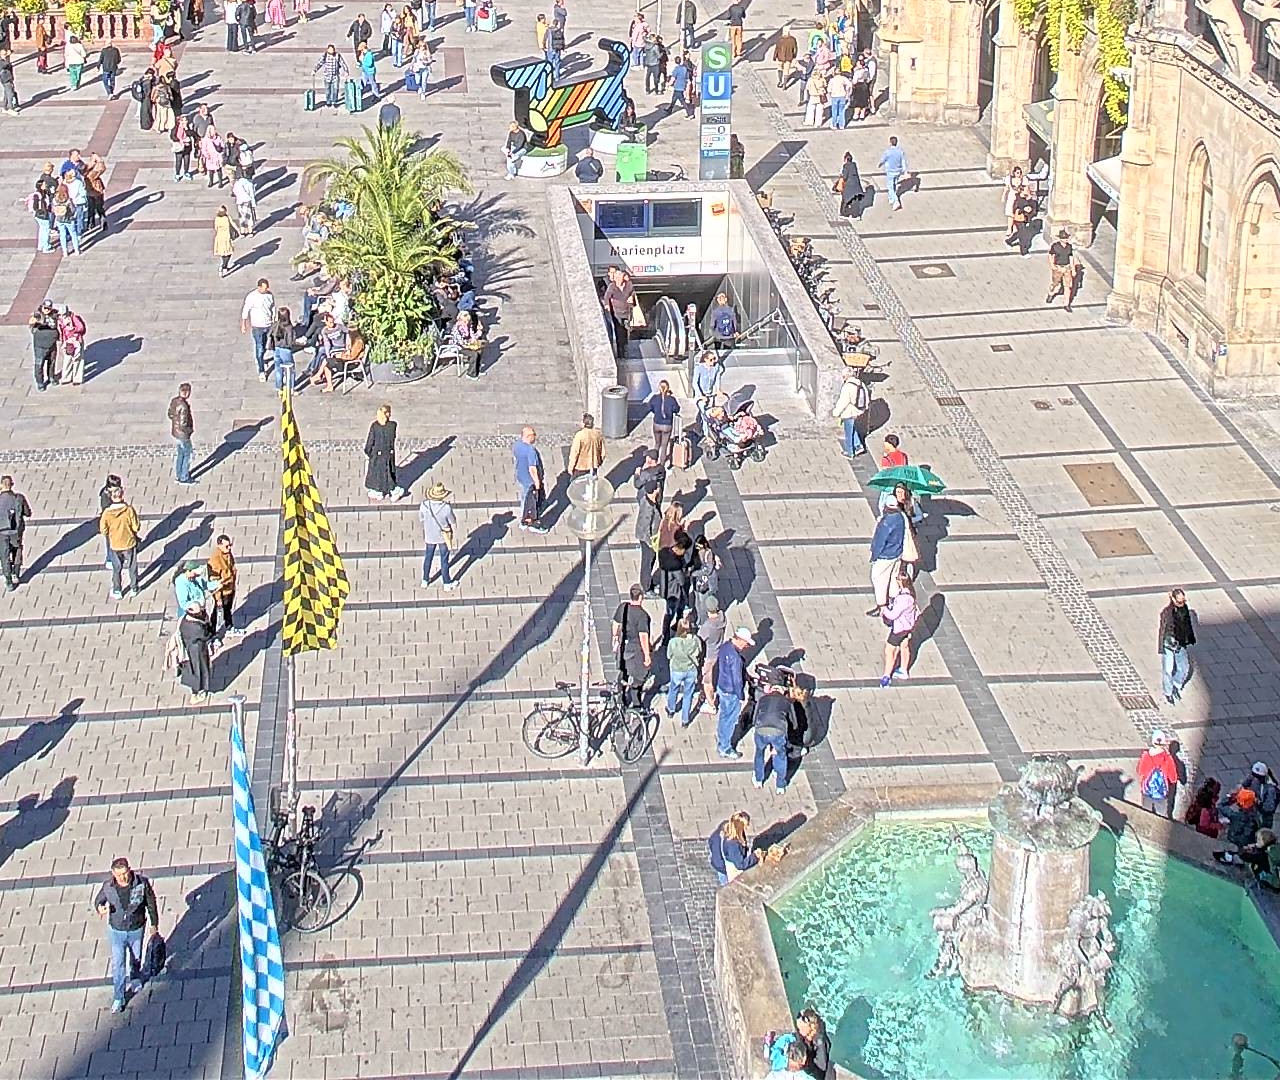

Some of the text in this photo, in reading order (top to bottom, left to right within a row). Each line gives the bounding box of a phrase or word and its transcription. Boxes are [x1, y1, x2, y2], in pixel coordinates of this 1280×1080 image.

[707, 46, 727, 69] S
[707, 75, 726, 97] U
[610, 244, 685, 257] Marienplatz
